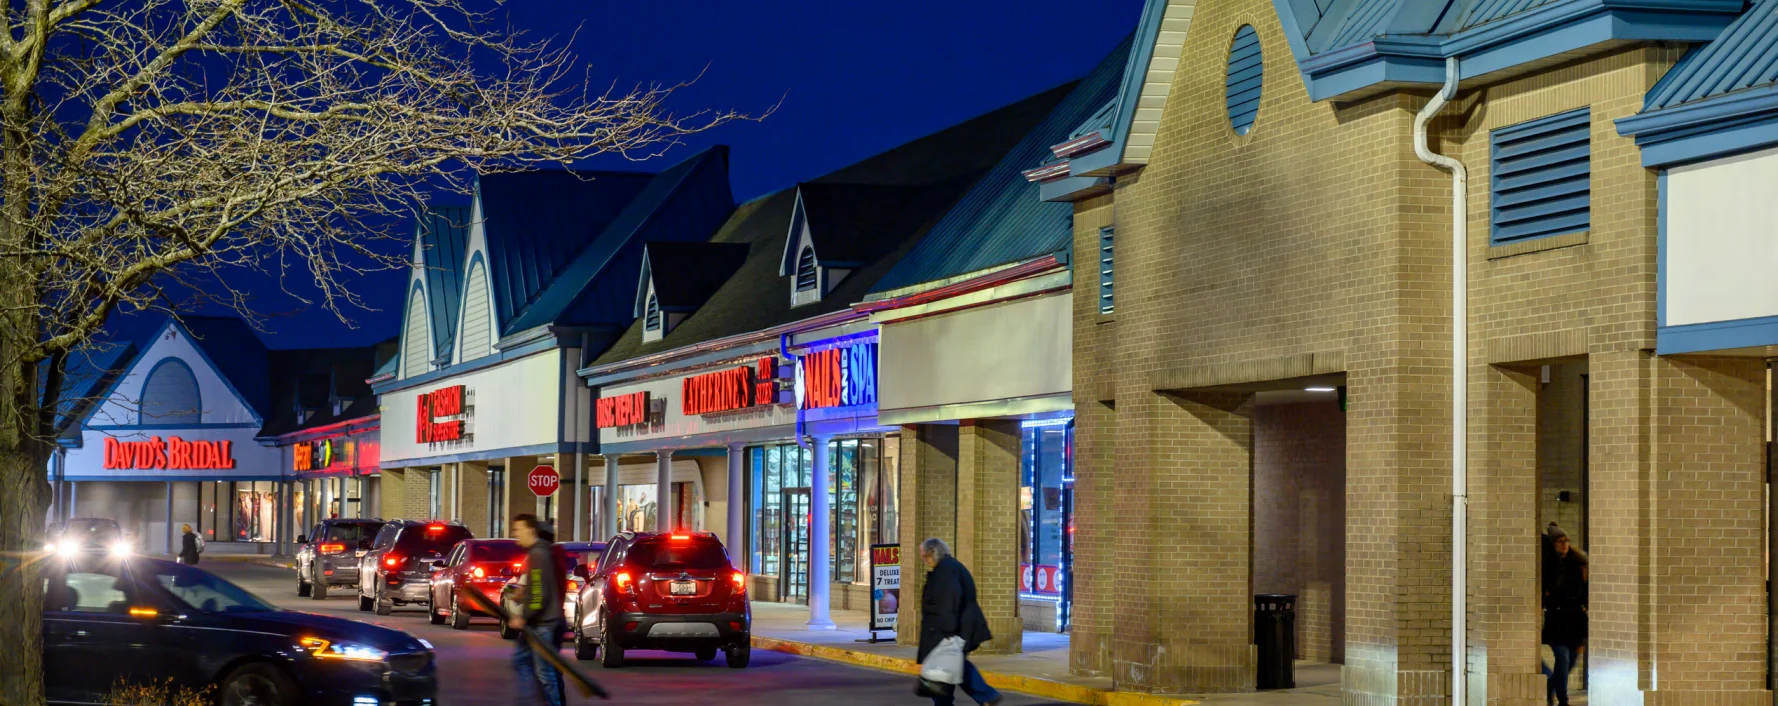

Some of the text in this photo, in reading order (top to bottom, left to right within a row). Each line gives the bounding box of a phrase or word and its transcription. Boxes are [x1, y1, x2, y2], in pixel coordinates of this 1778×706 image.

[757, 356, 772, 379] PLUS
[805, 343, 876, 410] NAILS AND SPA
[434, 385, 461, 417] FASHION
[682, 365, 749, 415] CATHERINE'S
[756, 382, 773, 404] SIZES
[596, 390, 645, 428] DISC REPLAY
[103, 435, 233, 469] DAVID'S BRIDAL
[530, 475, 558, 487] STOP
[873, 548, 899, 565] NAILS
[876, 578, 882, 586] 7
[880, 569, 900, 577] DELUXE
